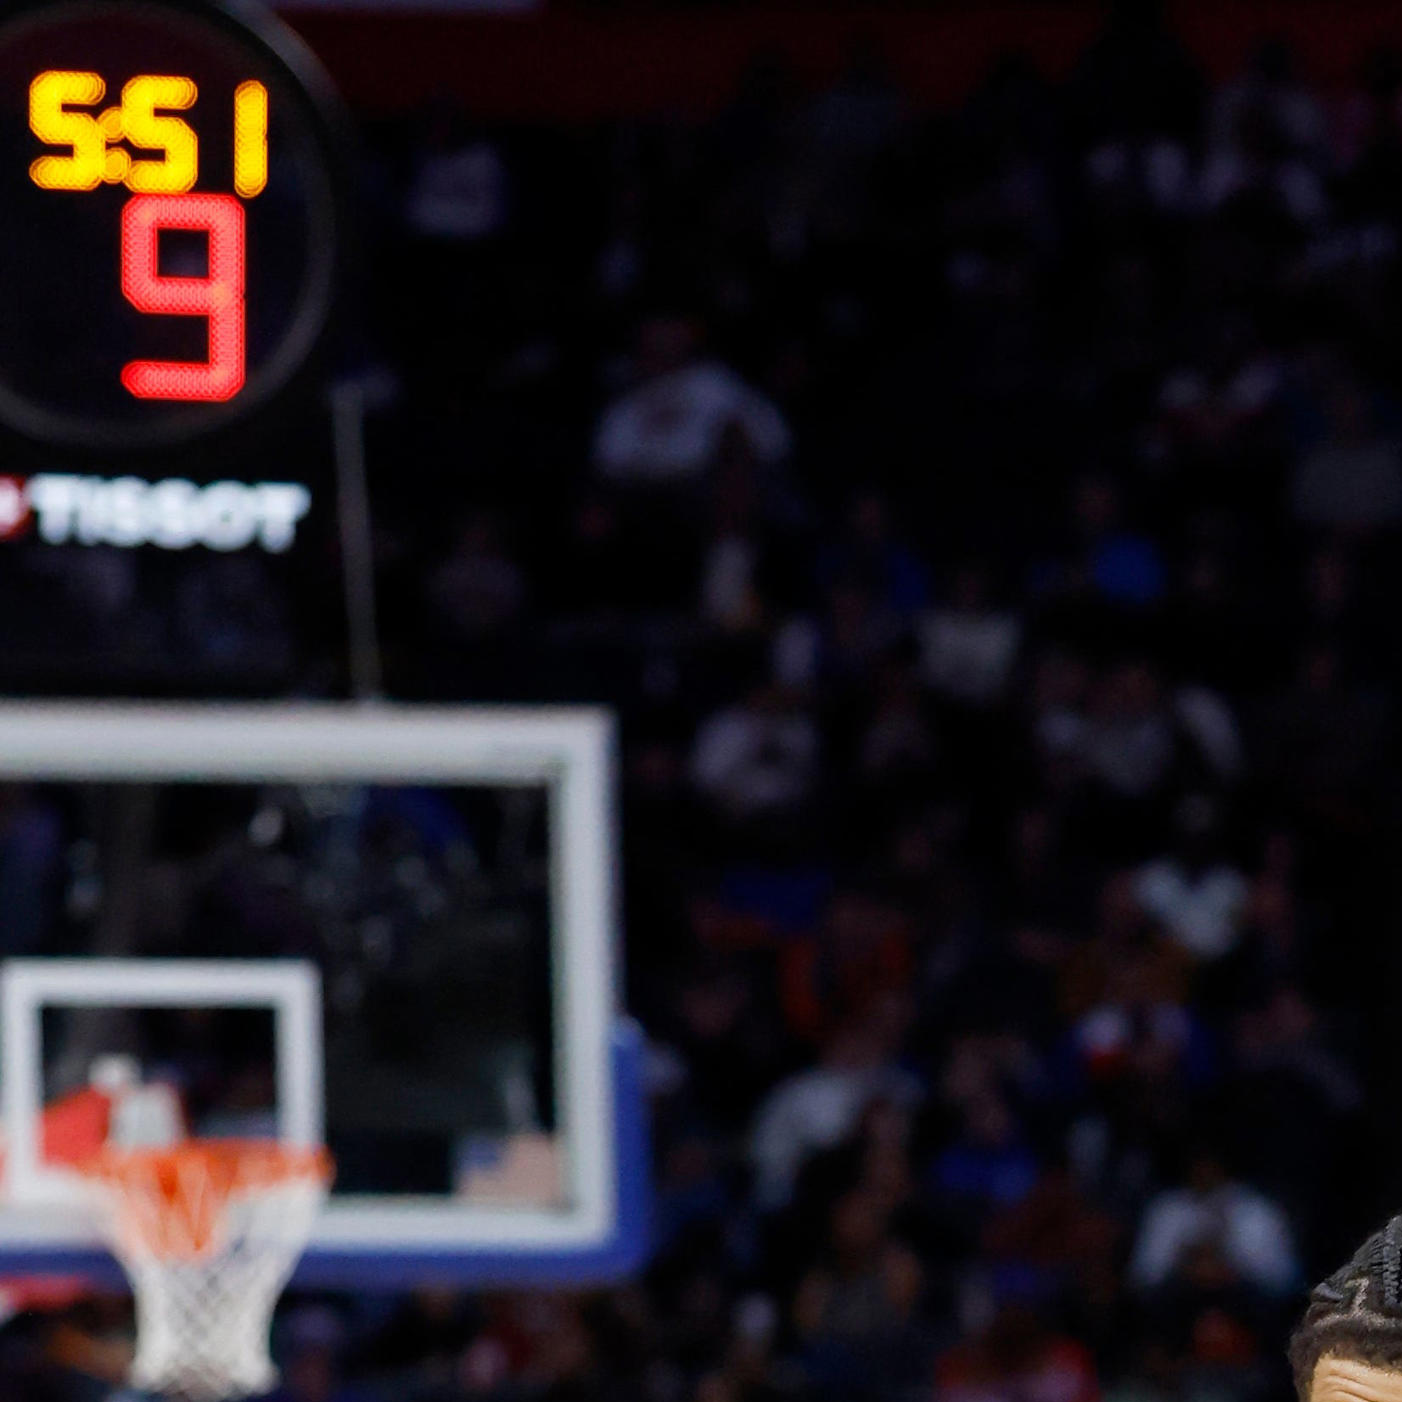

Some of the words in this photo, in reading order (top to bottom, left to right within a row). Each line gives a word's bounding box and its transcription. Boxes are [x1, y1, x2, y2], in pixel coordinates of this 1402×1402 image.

[28, 70, 269, 198] 5:51
[120, 192, 246, 402] 9
[26, 473, 312, 554] TISSOT
